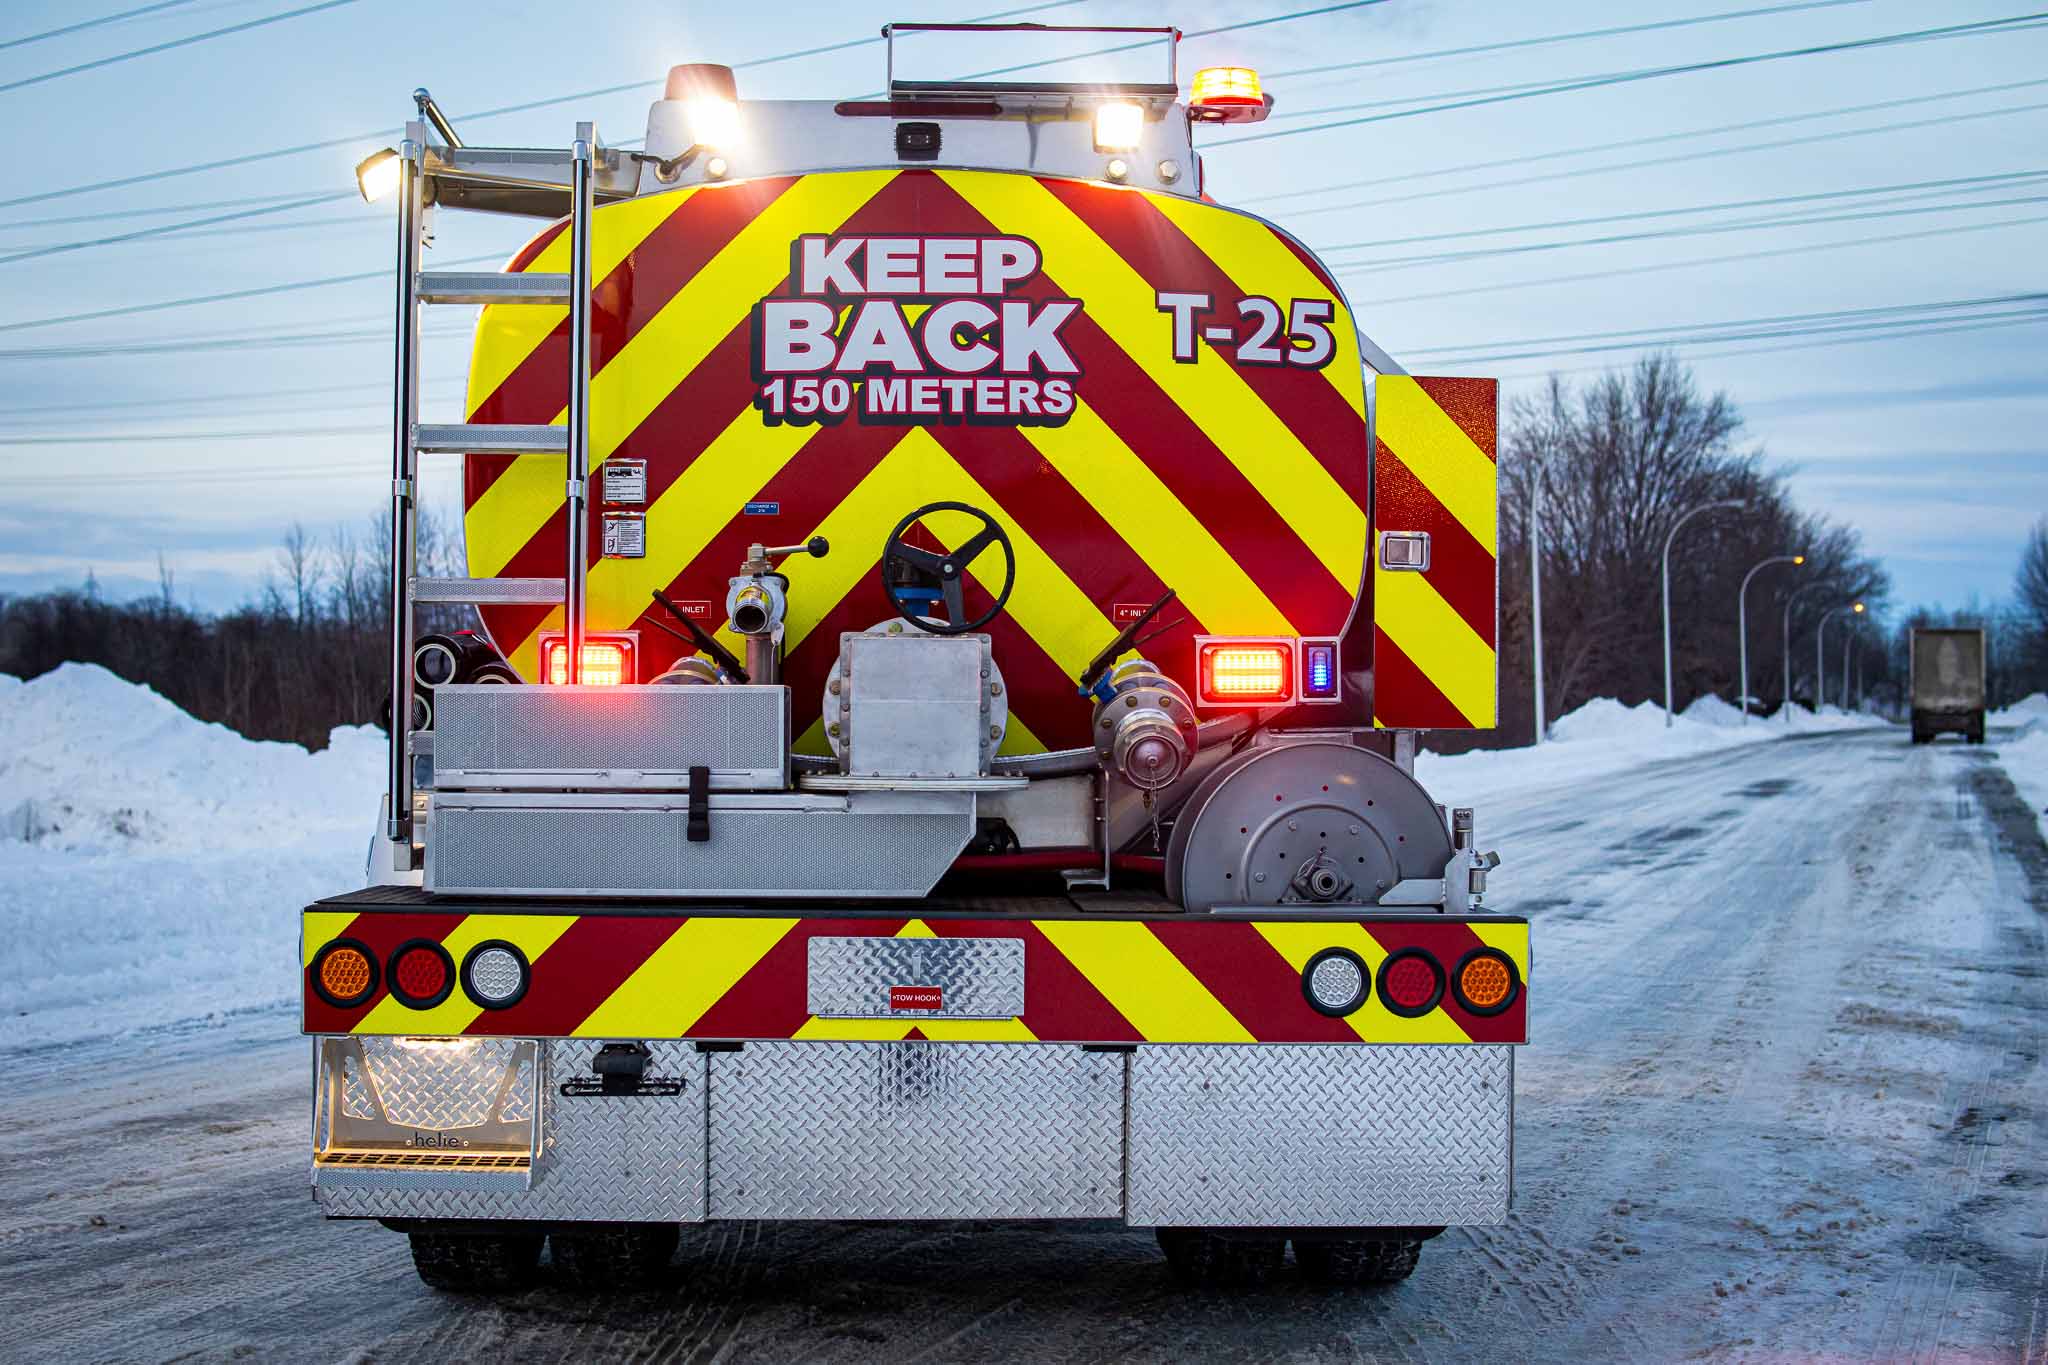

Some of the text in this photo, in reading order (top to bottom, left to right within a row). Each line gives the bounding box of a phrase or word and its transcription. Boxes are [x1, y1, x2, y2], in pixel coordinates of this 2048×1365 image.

[800, 236, 1039, 294] KEEP
[762, 300, 1082, 374] BACK
[1157, 292, 1334, 368] T-25
[762, 377, 1075, 415] 150 METERS
[896, 994, 937, 1002] TOW HOOK
[415, 1131, 459, 1147] helie
